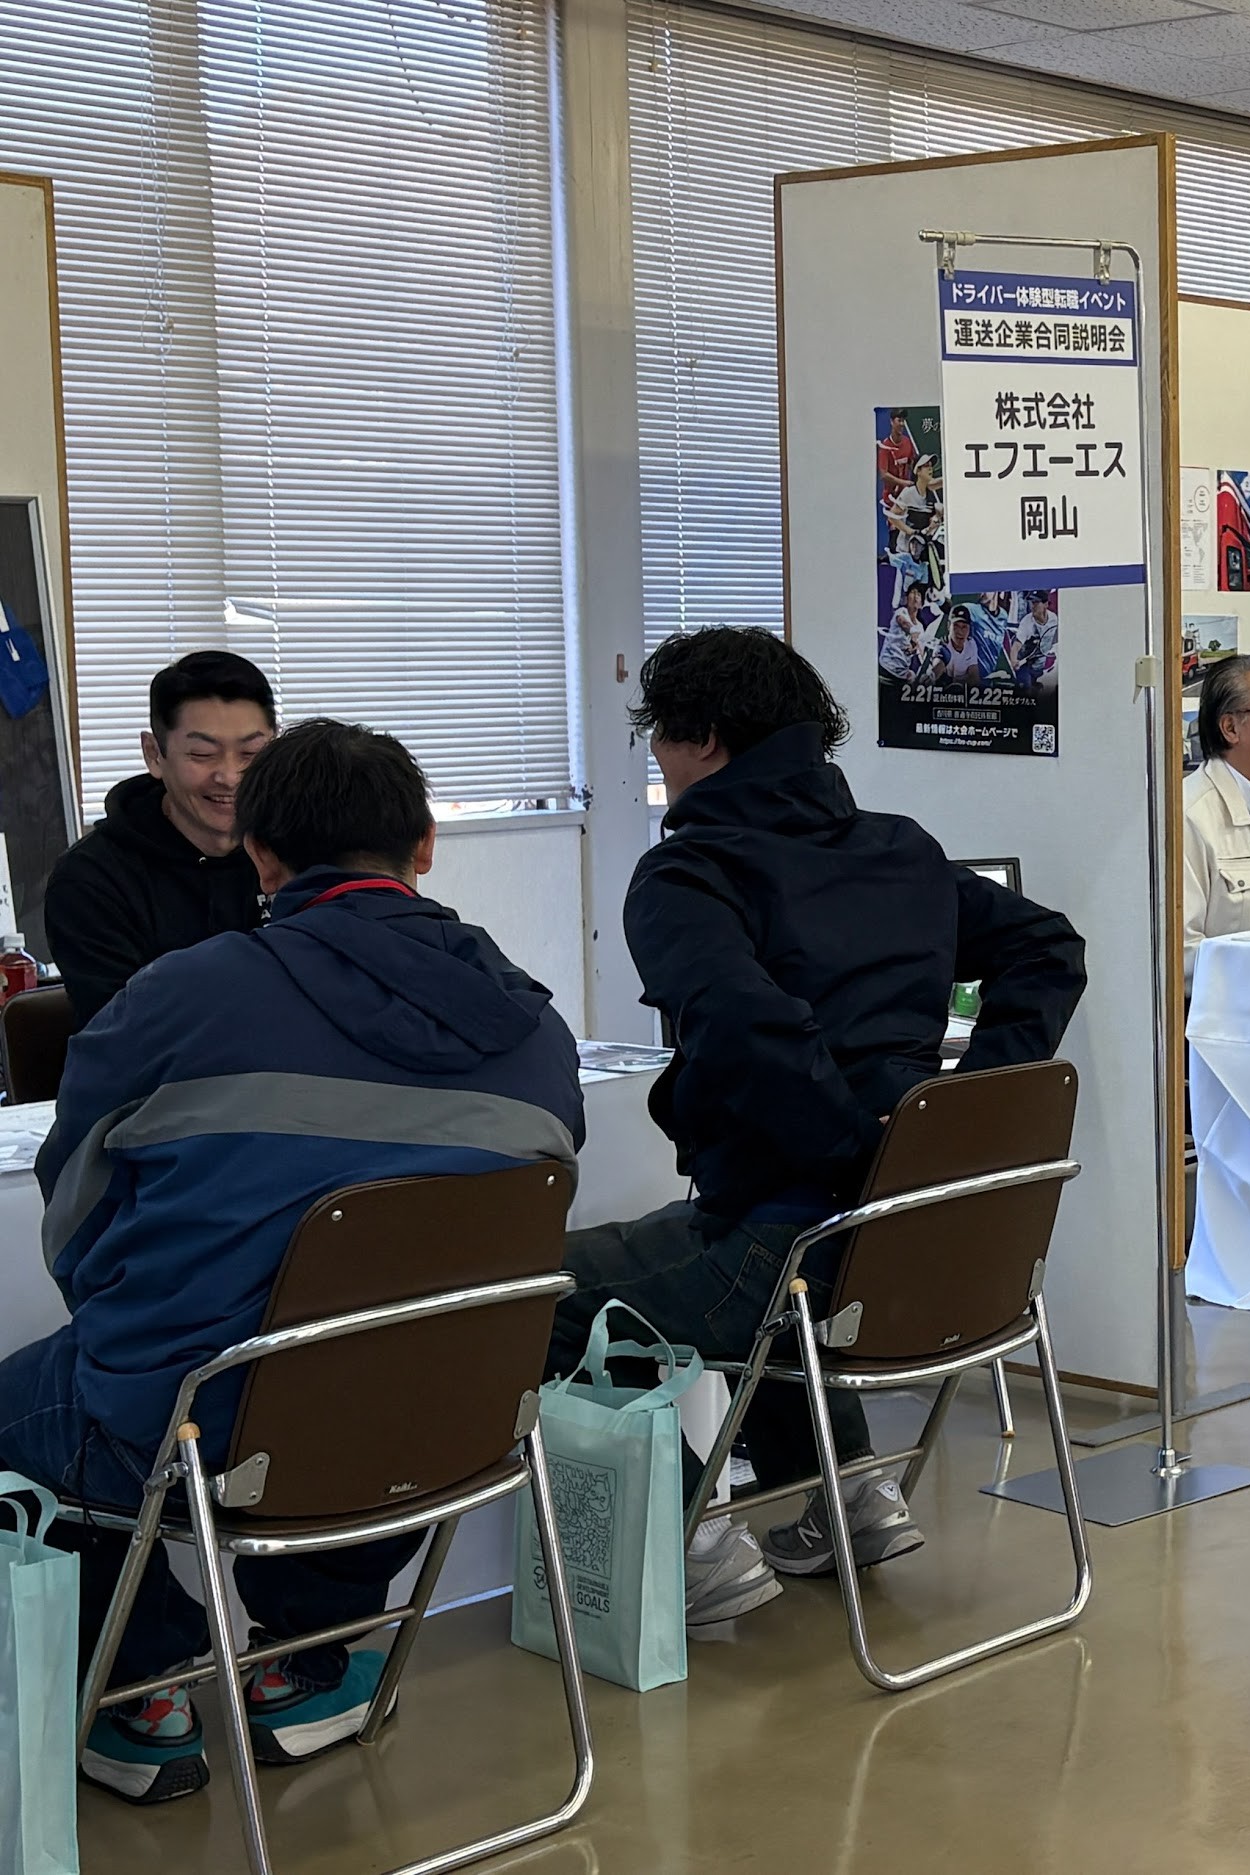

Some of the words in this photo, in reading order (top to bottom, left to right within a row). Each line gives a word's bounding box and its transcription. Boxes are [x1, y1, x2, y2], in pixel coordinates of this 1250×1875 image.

[952, 282, 1126, 312] ドライバー体験型転職イベント
[954, 318, 1125, 353] 運送企業合同説明会
[995, 391, 1096, 430] 株式会社
[964, 442, 1126, 479] エフエーエス
[1020, 495, 1079, 540] 岡山
[901, 684, 932, 703] 2.21
[969, 687, 1001, 706] 2.22
[576, 1591, 610, 1613] GOALS
